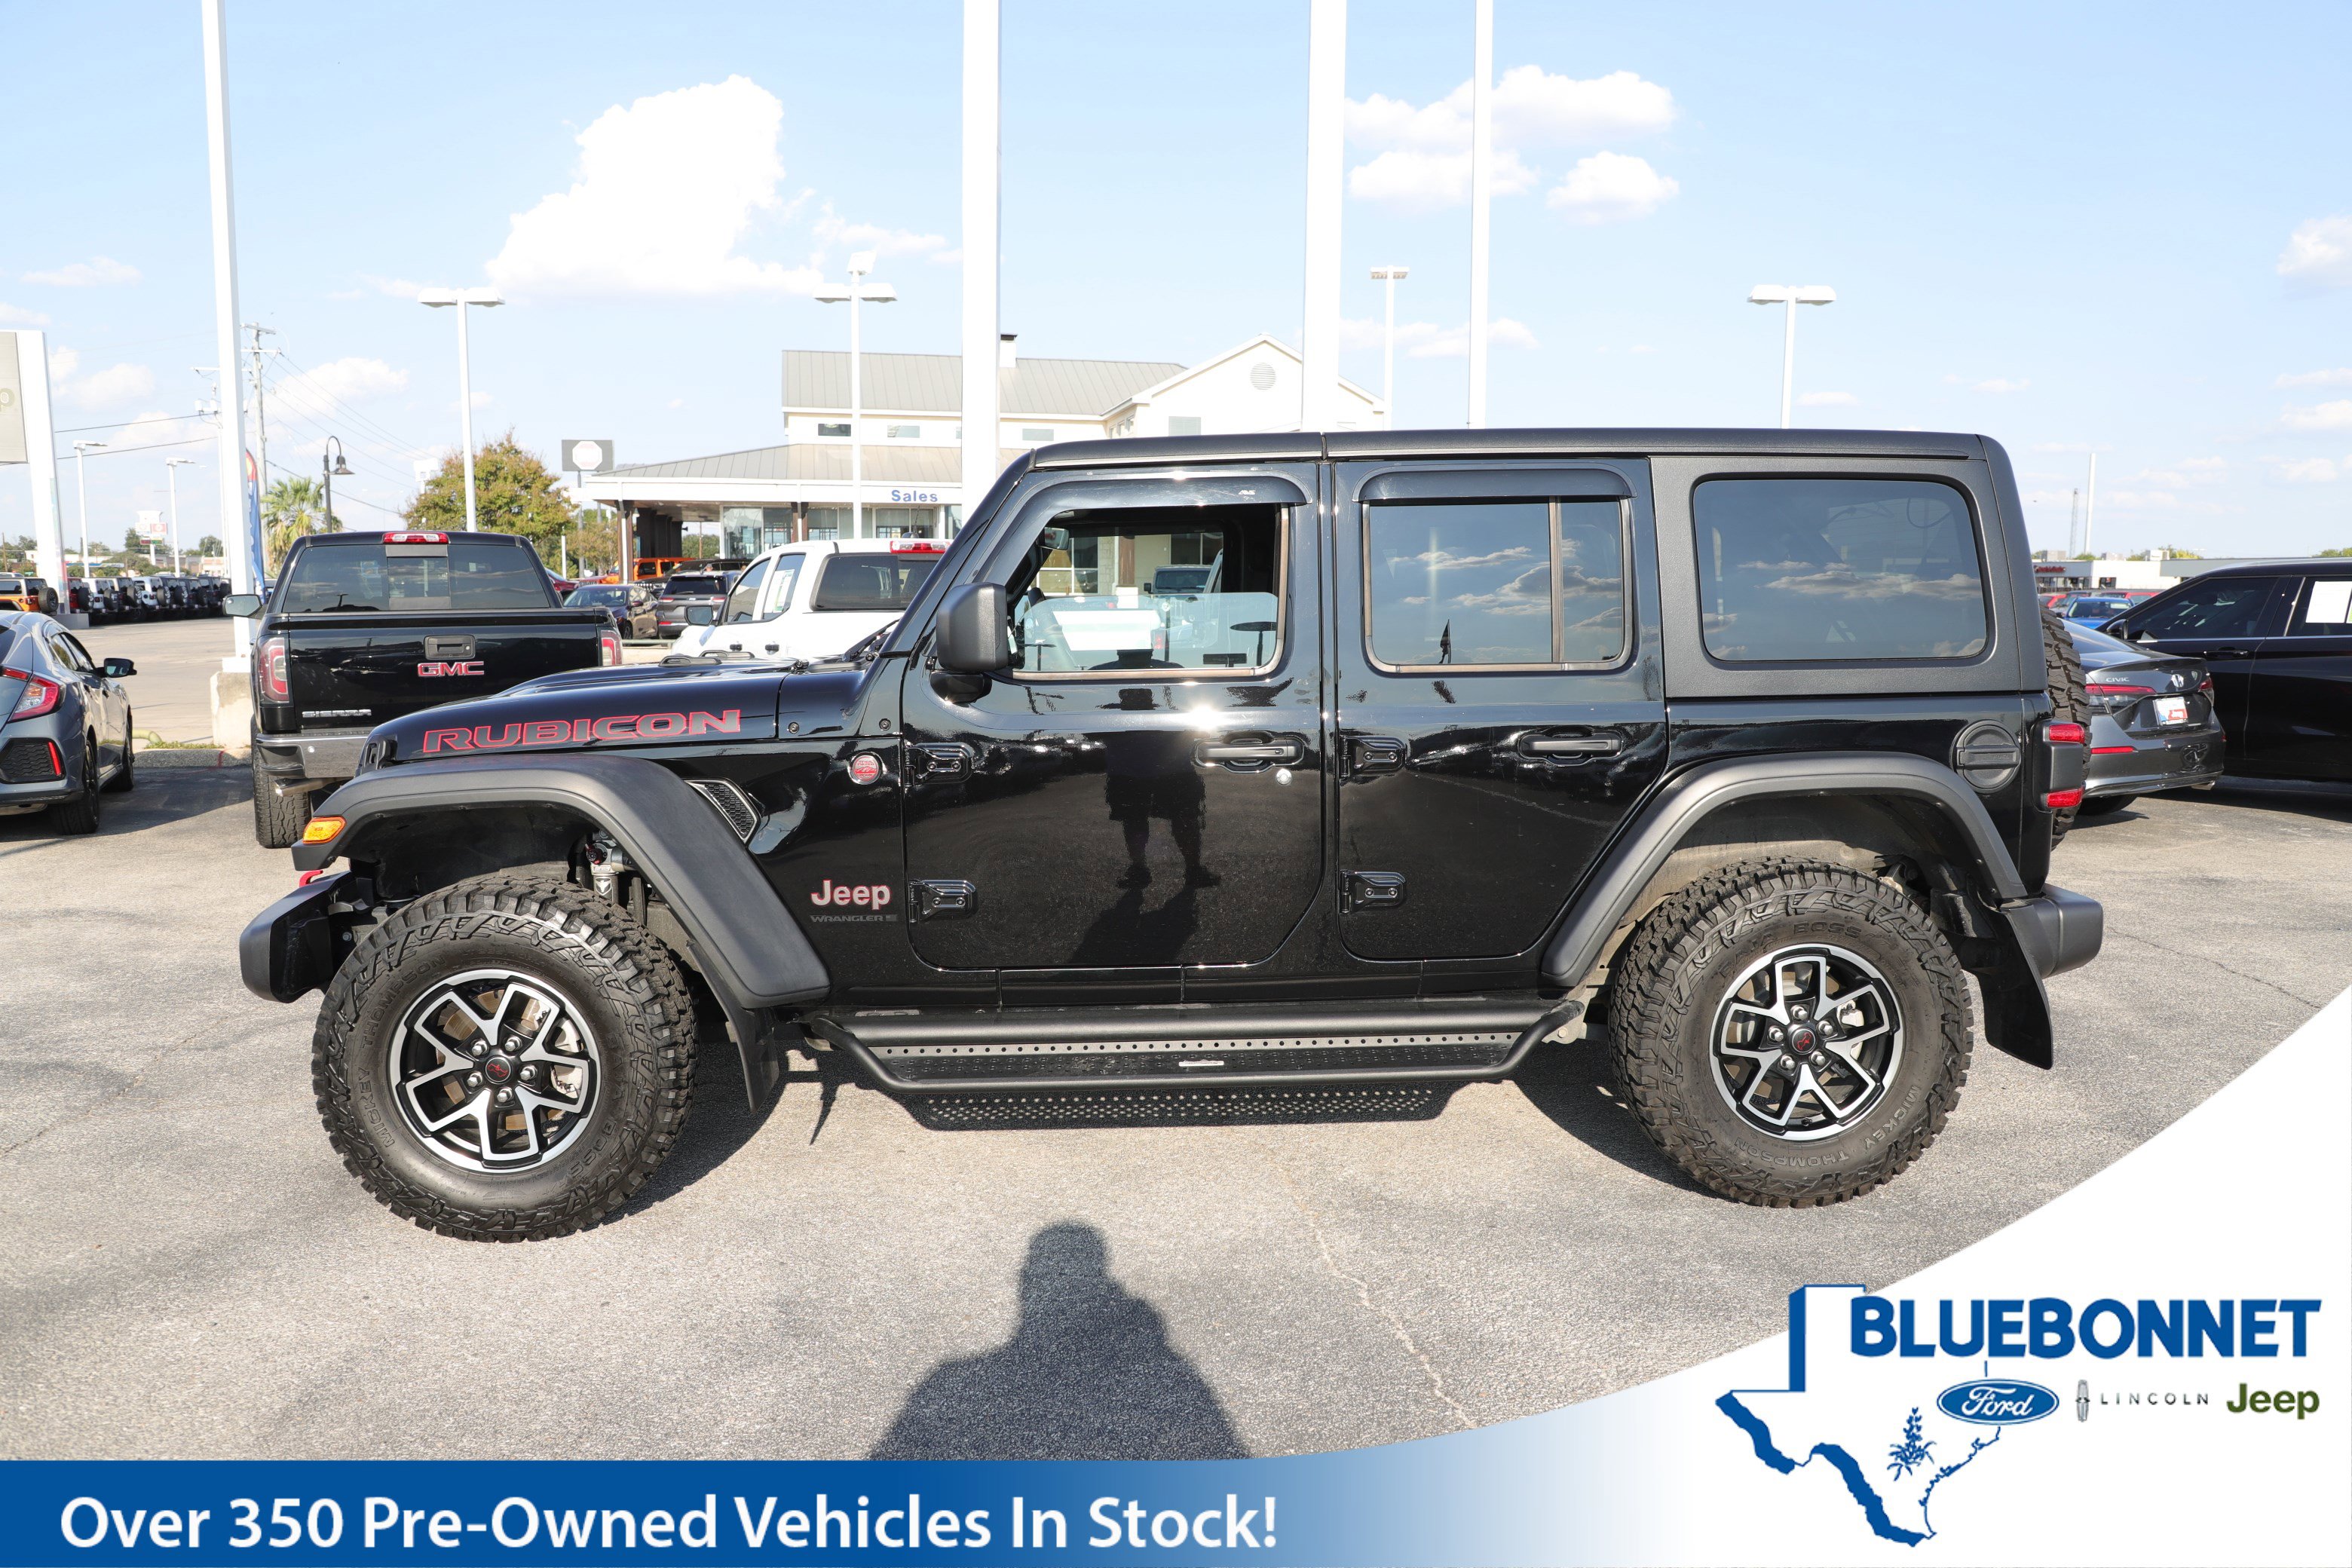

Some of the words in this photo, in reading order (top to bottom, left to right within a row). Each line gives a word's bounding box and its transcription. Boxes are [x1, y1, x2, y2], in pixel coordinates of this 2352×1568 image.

[891, 489, 939, 503] Sales
[418, 661, 485, 677] GMC
[423, 709, 741, 753] RUBICON
[810, 879, 891, 911] Jeep
[810, 914, 884, 923] WRANGLER
[1793, 921, 1861, 939] BOSS
[362, 955, 446, 1049] THOMPSON
[357, 1066, 396, 1148] MICKEY
[1865, 1086, 1922, 1149] MICKEY
[1735, 1137, 1850, 1167] THOMPSON
